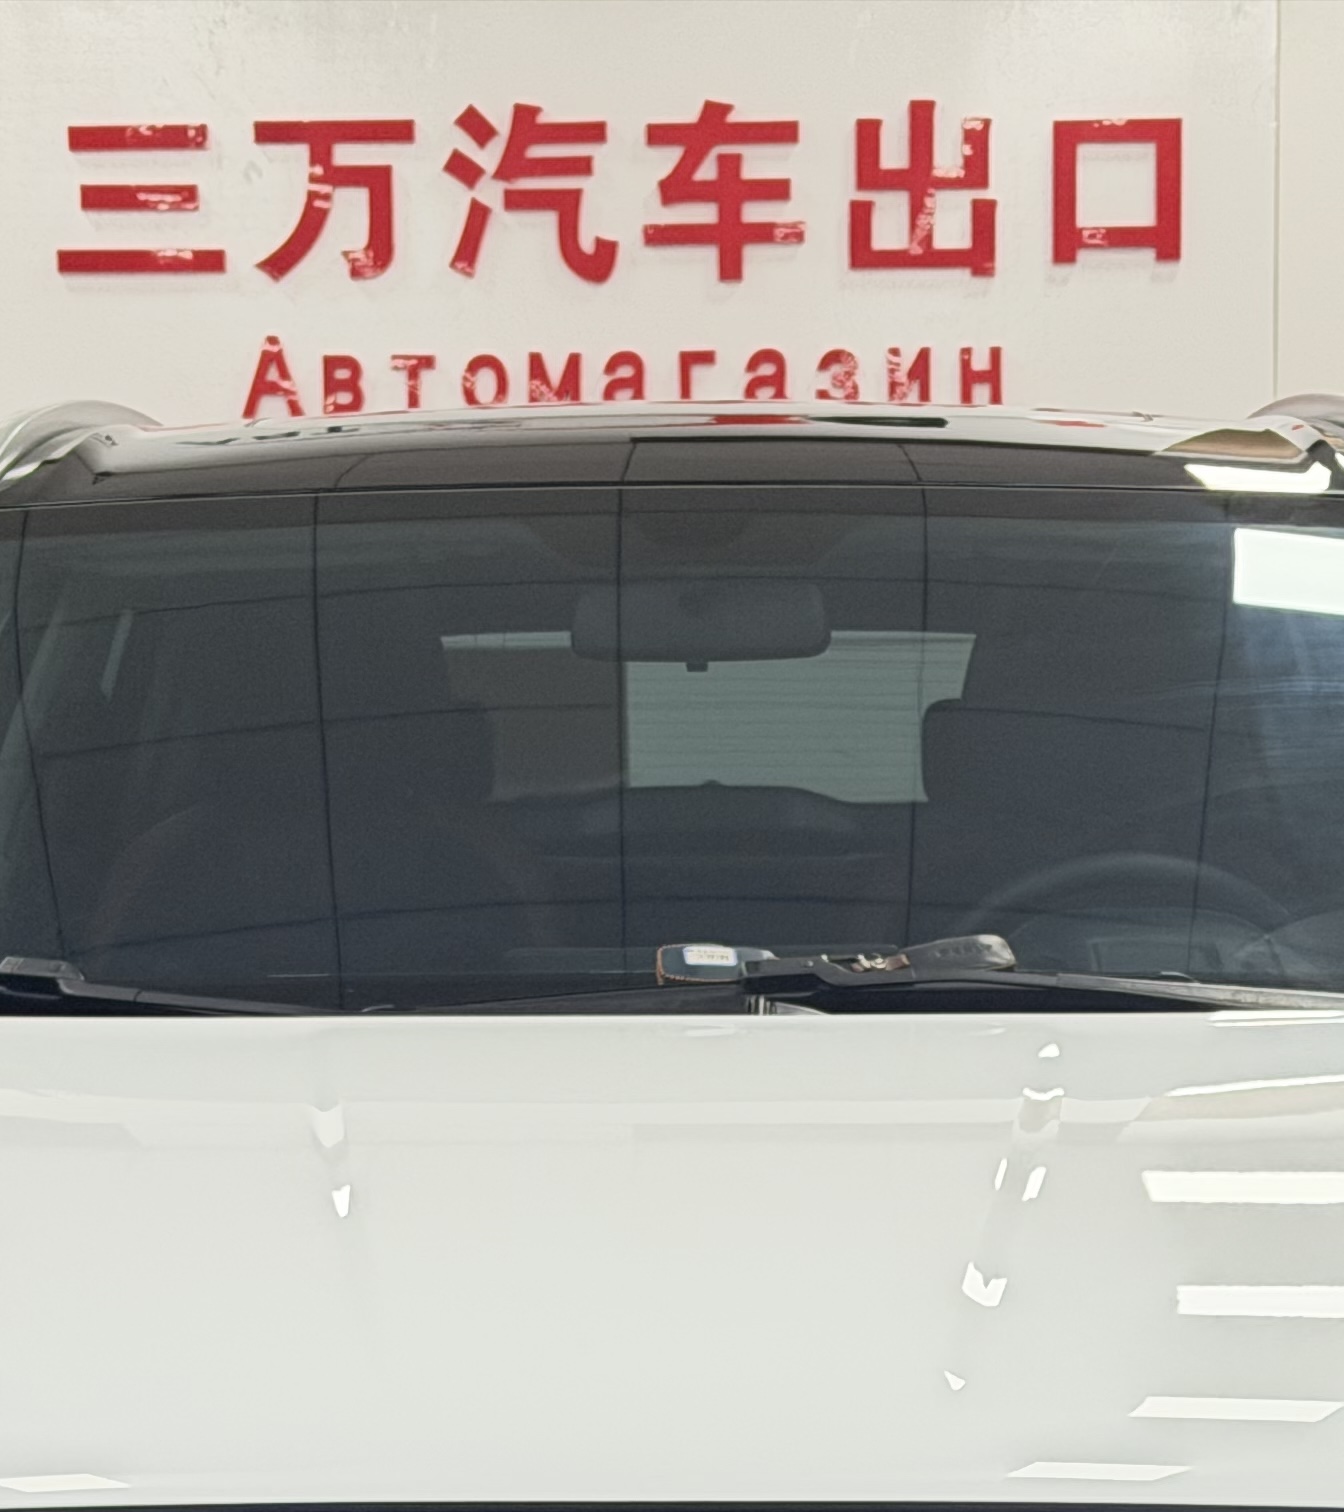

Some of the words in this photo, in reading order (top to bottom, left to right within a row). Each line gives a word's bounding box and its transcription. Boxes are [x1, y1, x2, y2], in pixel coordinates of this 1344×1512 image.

[56, 99, 1183, 284] 三万汽车出口
